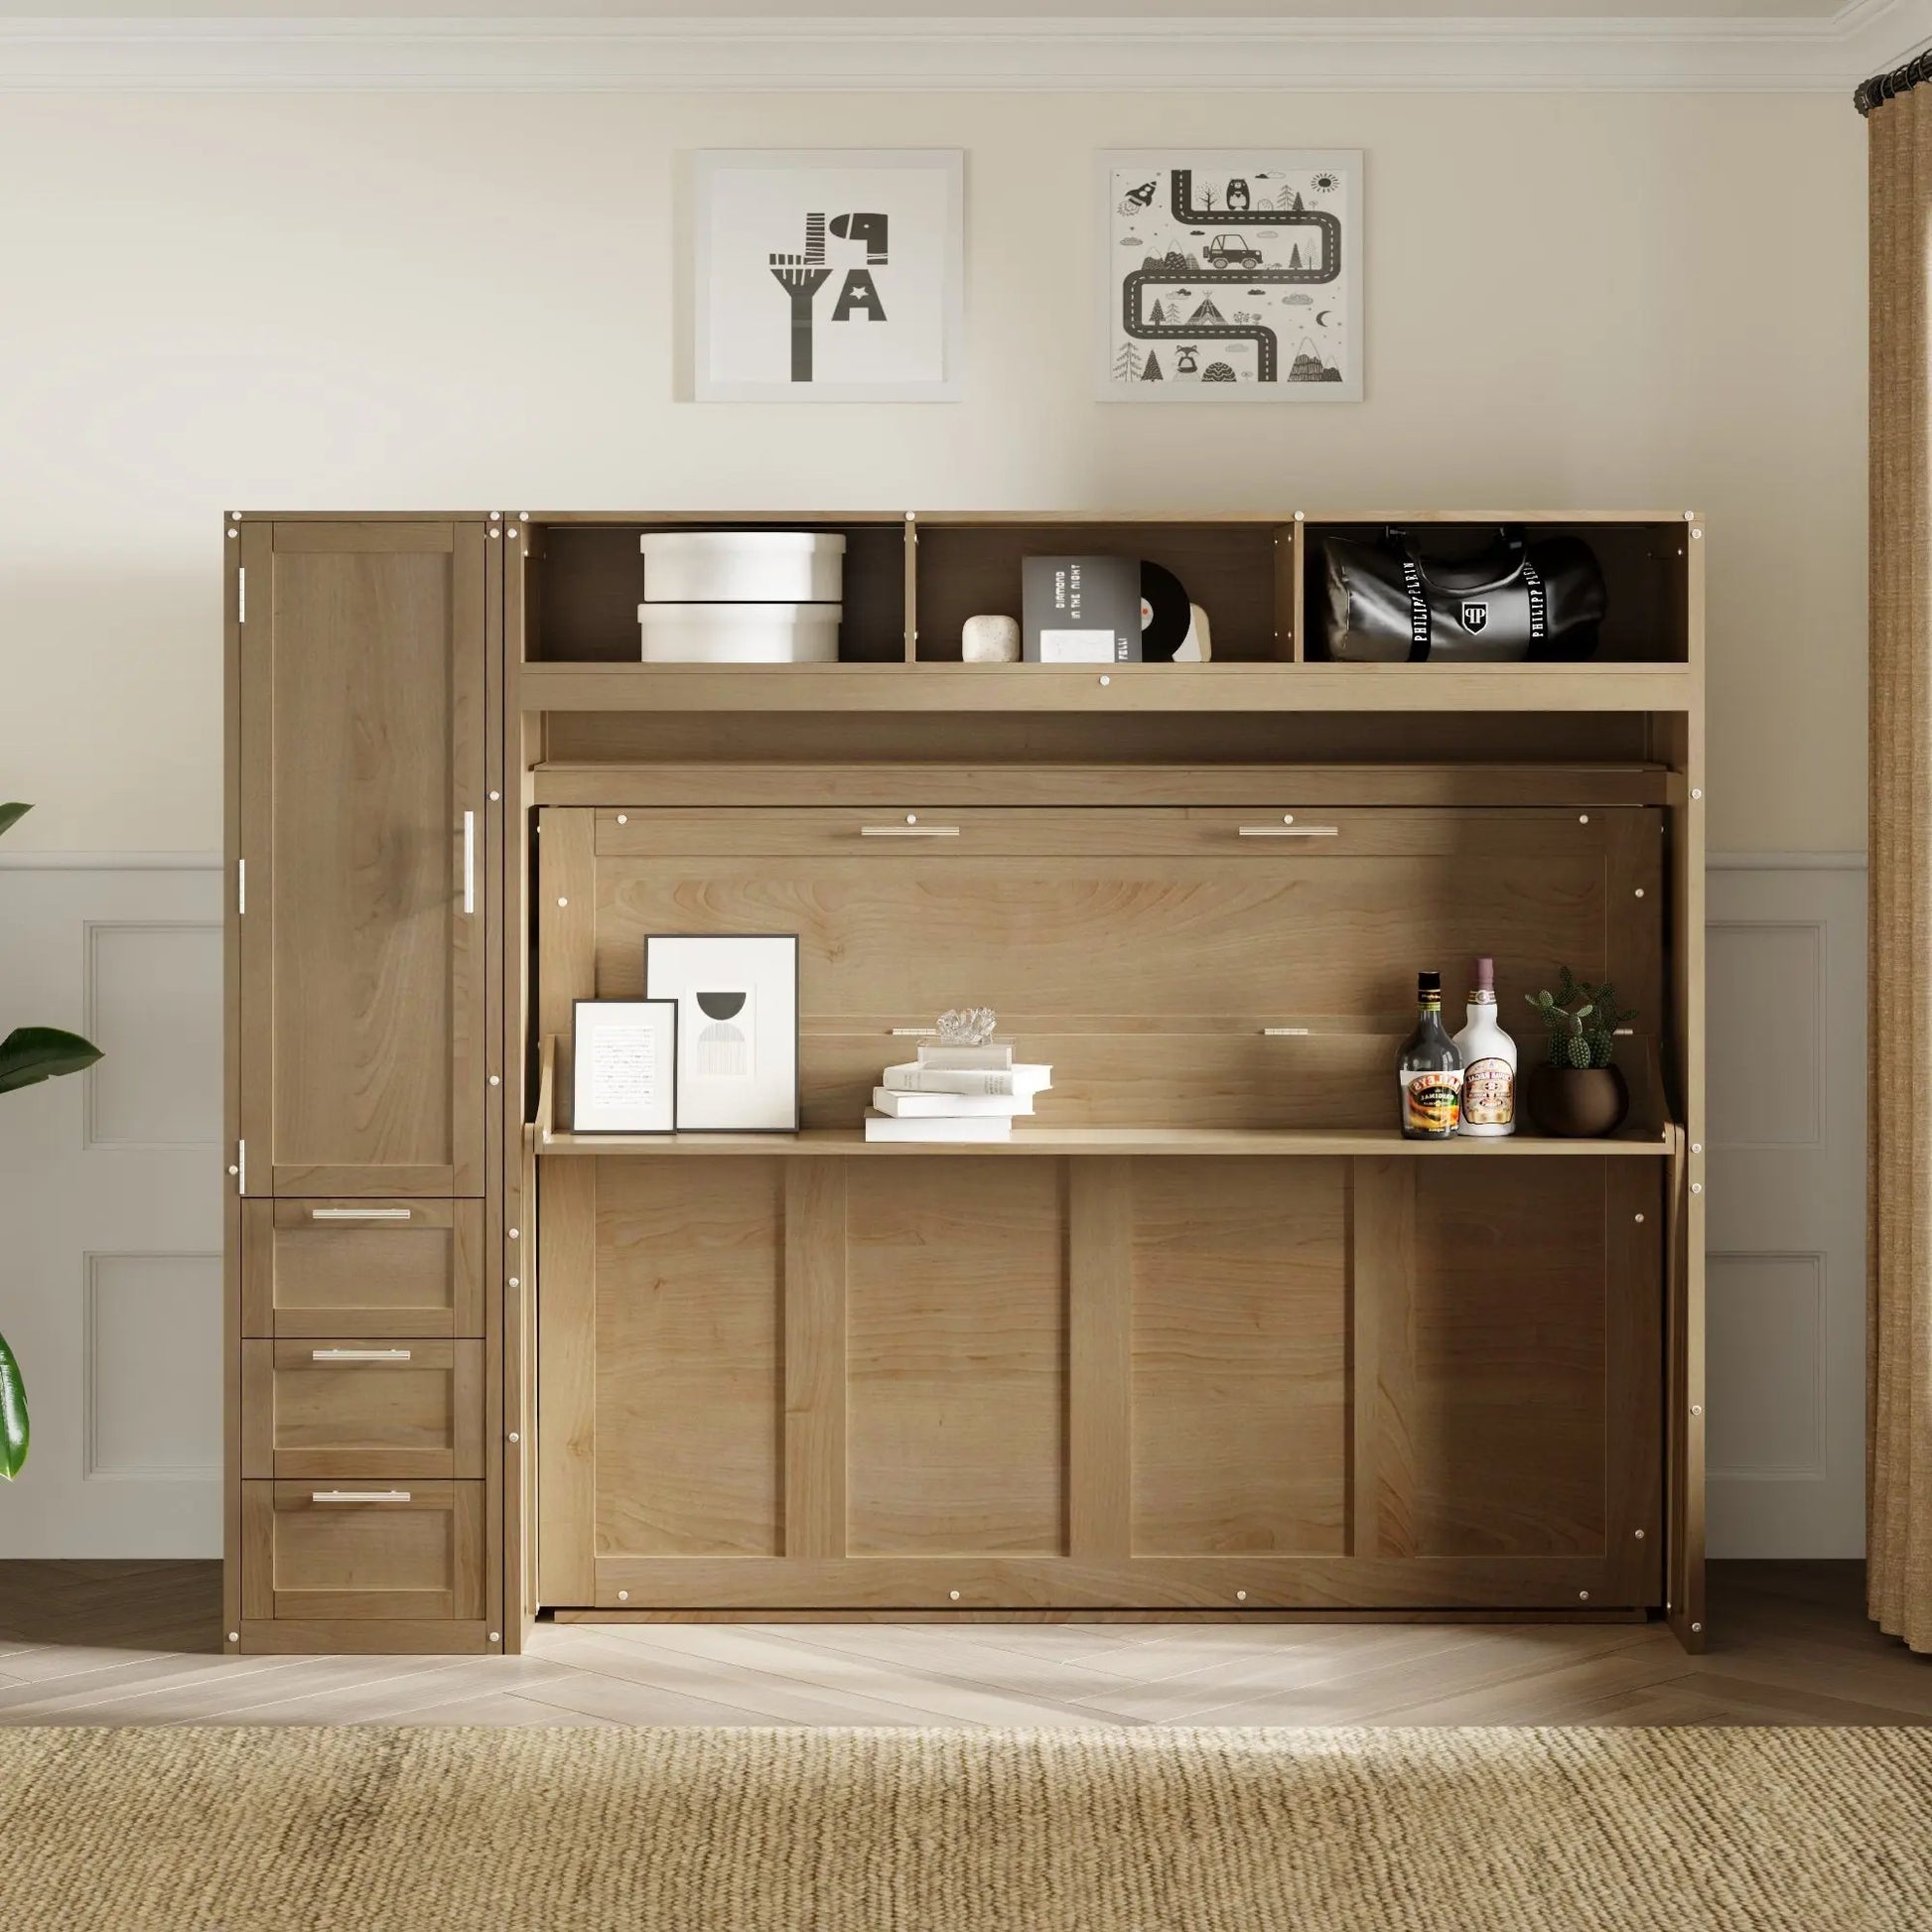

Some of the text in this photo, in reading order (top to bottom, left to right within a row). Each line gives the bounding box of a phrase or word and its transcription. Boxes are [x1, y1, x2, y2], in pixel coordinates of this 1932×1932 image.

[1055, 571, 1065, 609] DIAMOND
[1070, 564, 1081, 620] IN THE NIGHT
[1403, 562, 1421, 595] PLEIN
[1530, 590, 1544, 637] PHILIPP
